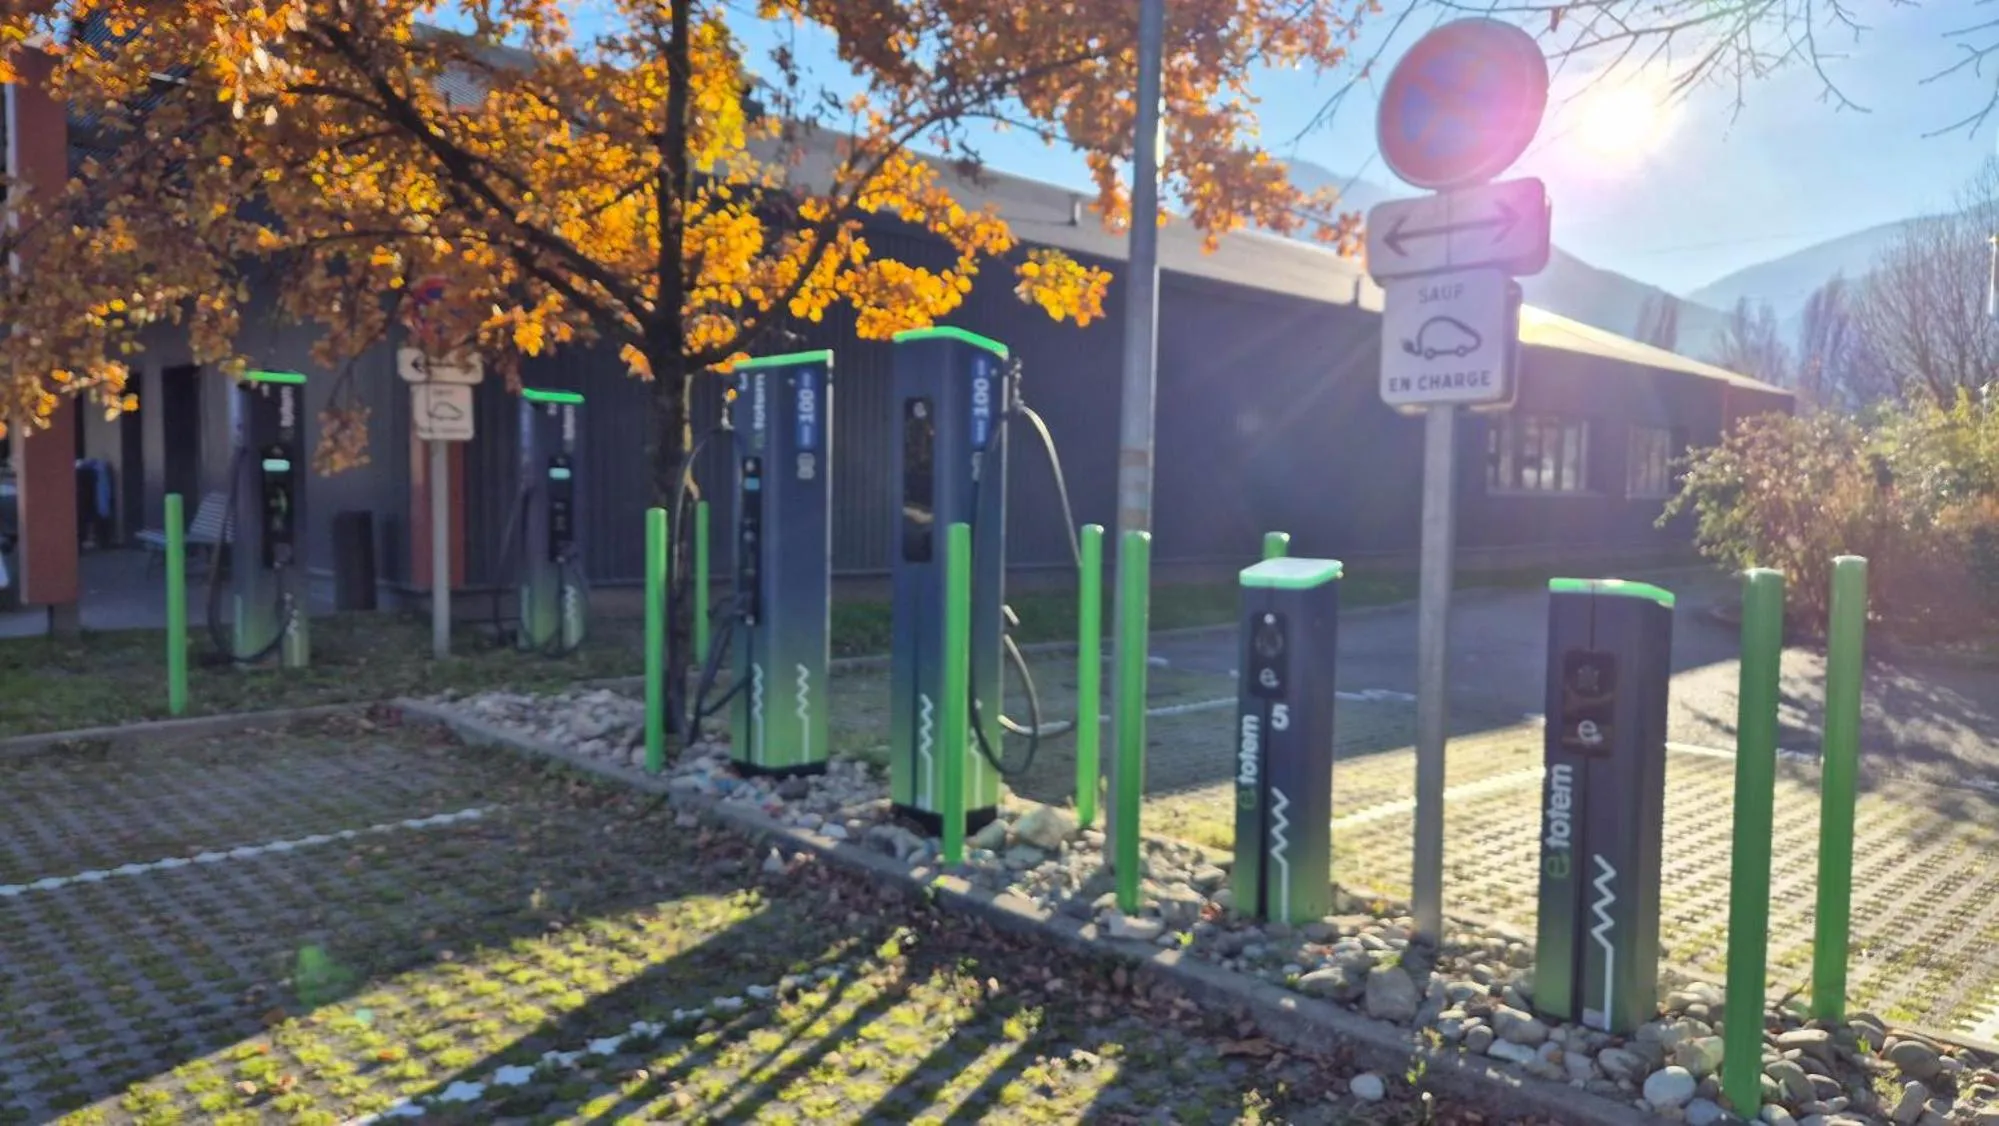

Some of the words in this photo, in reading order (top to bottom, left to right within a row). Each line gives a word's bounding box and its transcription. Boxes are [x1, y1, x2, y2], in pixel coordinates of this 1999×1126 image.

[1417, 283, 1465, 304] SAUF
[1388, 376, 1411, 393] EN
[1417, 370, 1493, 392] CHARGE
[798, 388, 815, 424] 100
[973, 377, 990, 417] 100
[1271, 703, 1290, 730] 5
